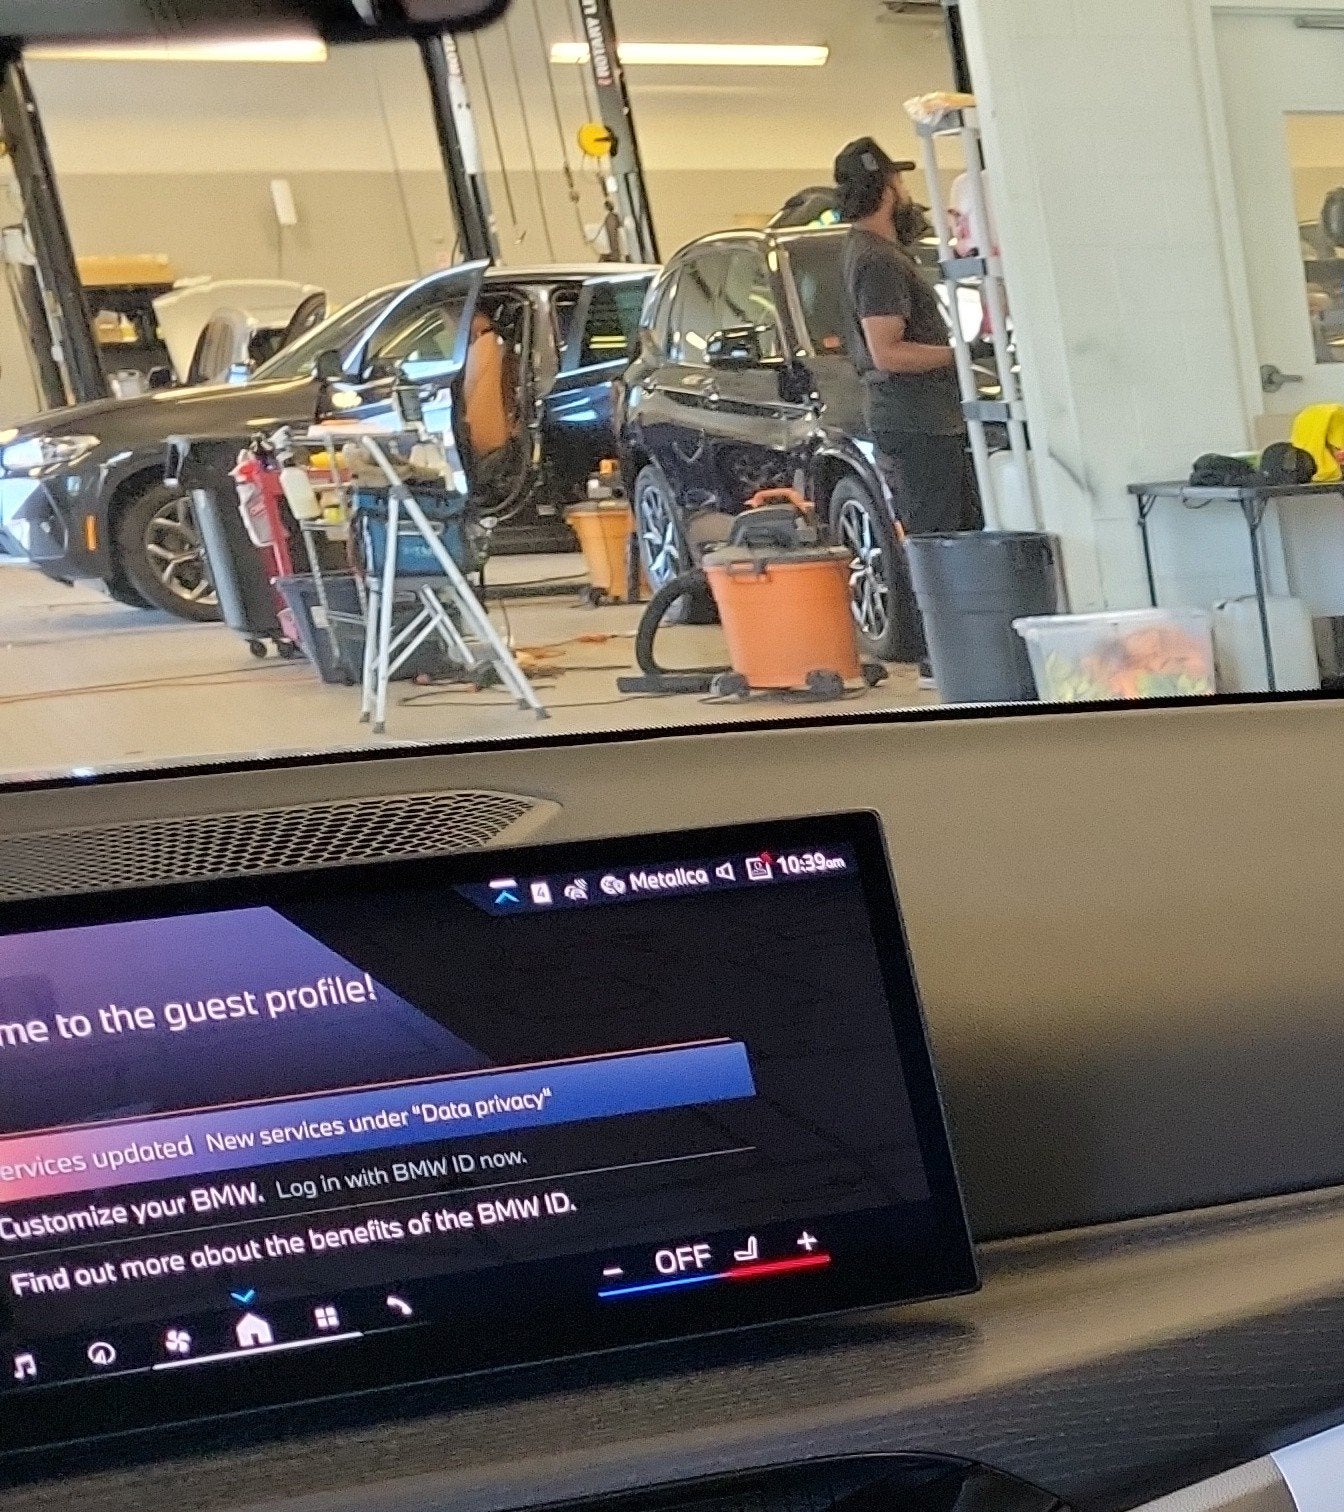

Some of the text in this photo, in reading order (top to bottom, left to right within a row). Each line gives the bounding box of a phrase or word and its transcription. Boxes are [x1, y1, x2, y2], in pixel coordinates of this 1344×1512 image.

[56, 1013, 92, 1039] to
[99, 1006, 155, 1034] the
[164, 990, 259, 1032] guest
[267, 972, 378, 1019] profile!
[92, 1134, 194, 1171] updated
[206, 1132, 255, 1152] New
[261, 1118, 345, 1146] services
[350, 1109, 409, 1134] under
[275, 1150, 527, 1200] Log in with BMW ID now.
[0, 1182, 266, 1241] Customize your BMW.
[10, 1190, 577, 1297] Find out more about the benefits of the BMW ID.
[655, 1244, 712, 1274] OFF
